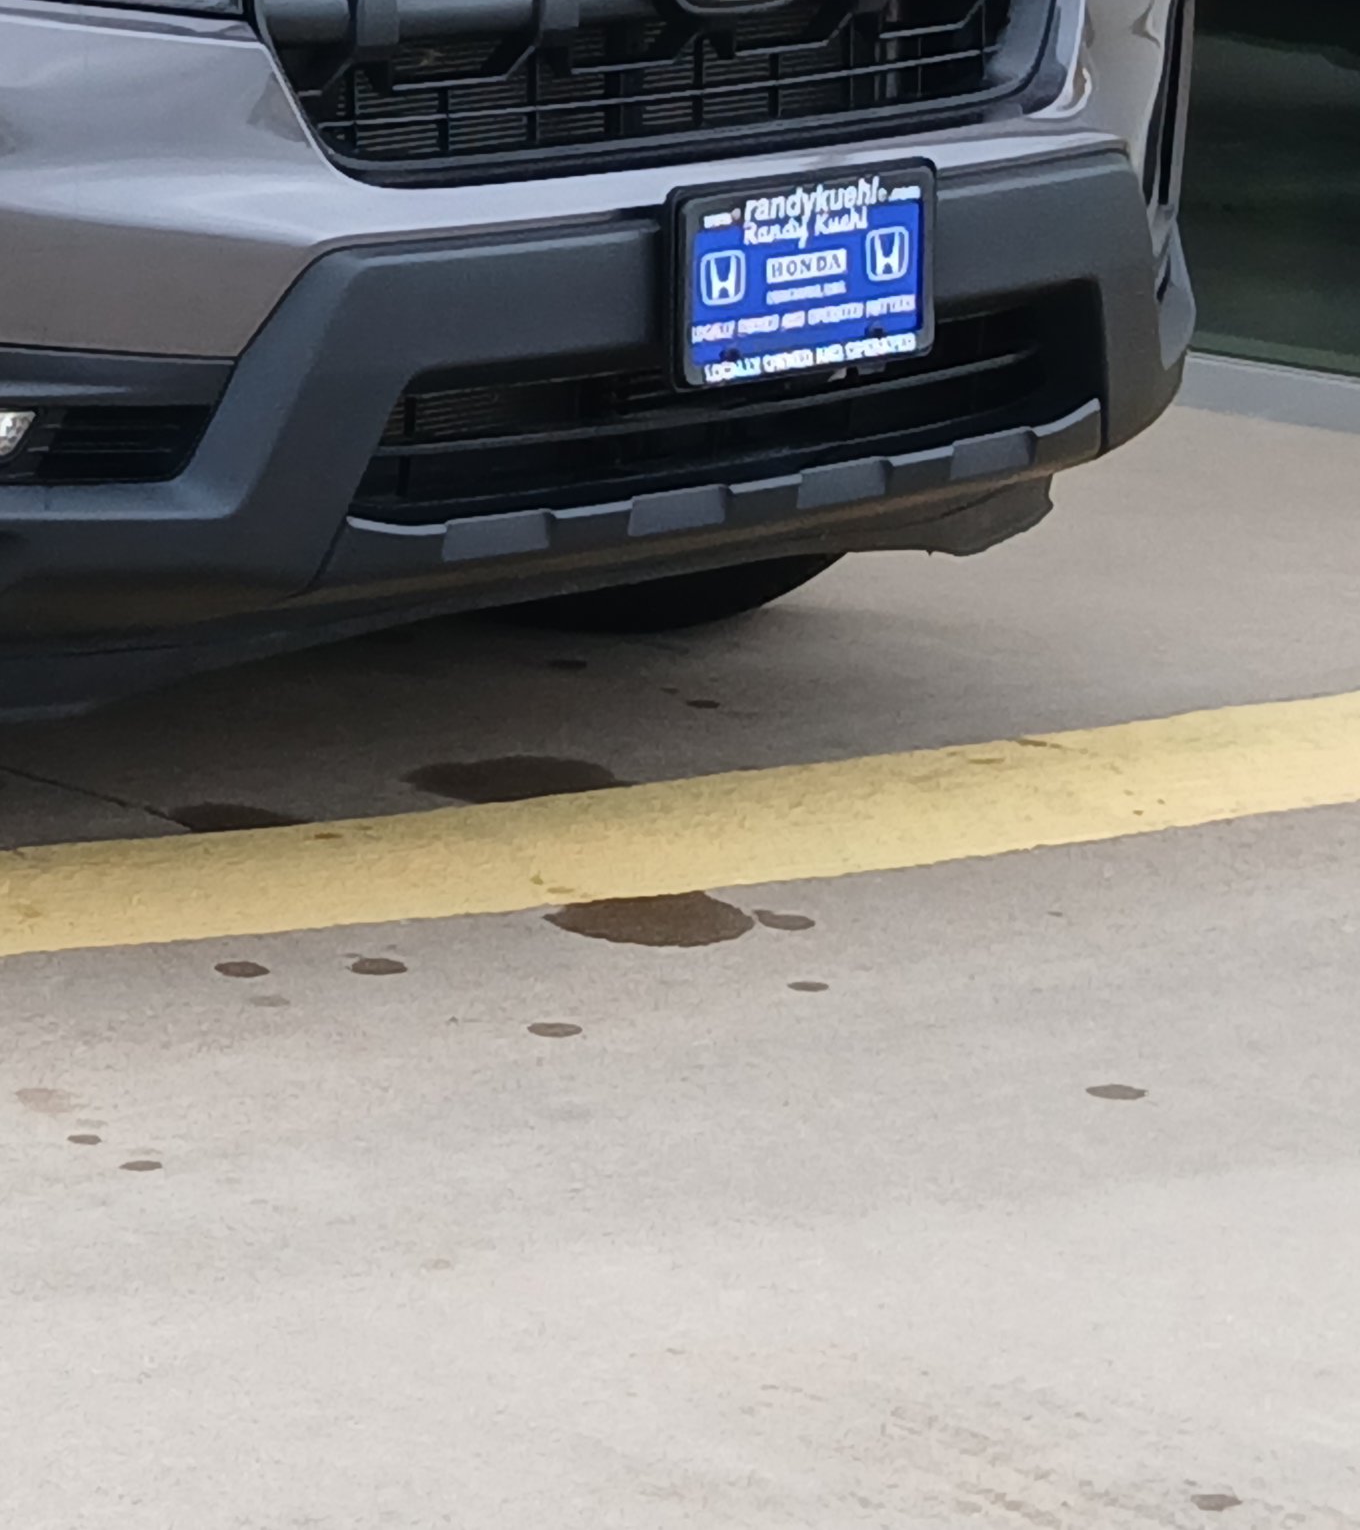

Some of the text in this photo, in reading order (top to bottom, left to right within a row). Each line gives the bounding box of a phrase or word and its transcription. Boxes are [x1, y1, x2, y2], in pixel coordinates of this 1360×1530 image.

[743, 217, 810, 249] Randy
[814, 206, 868, 236] Kuehl
[771, 253, 842, 279] HONDA
[705, 356, 761, 383] LOCALLY
